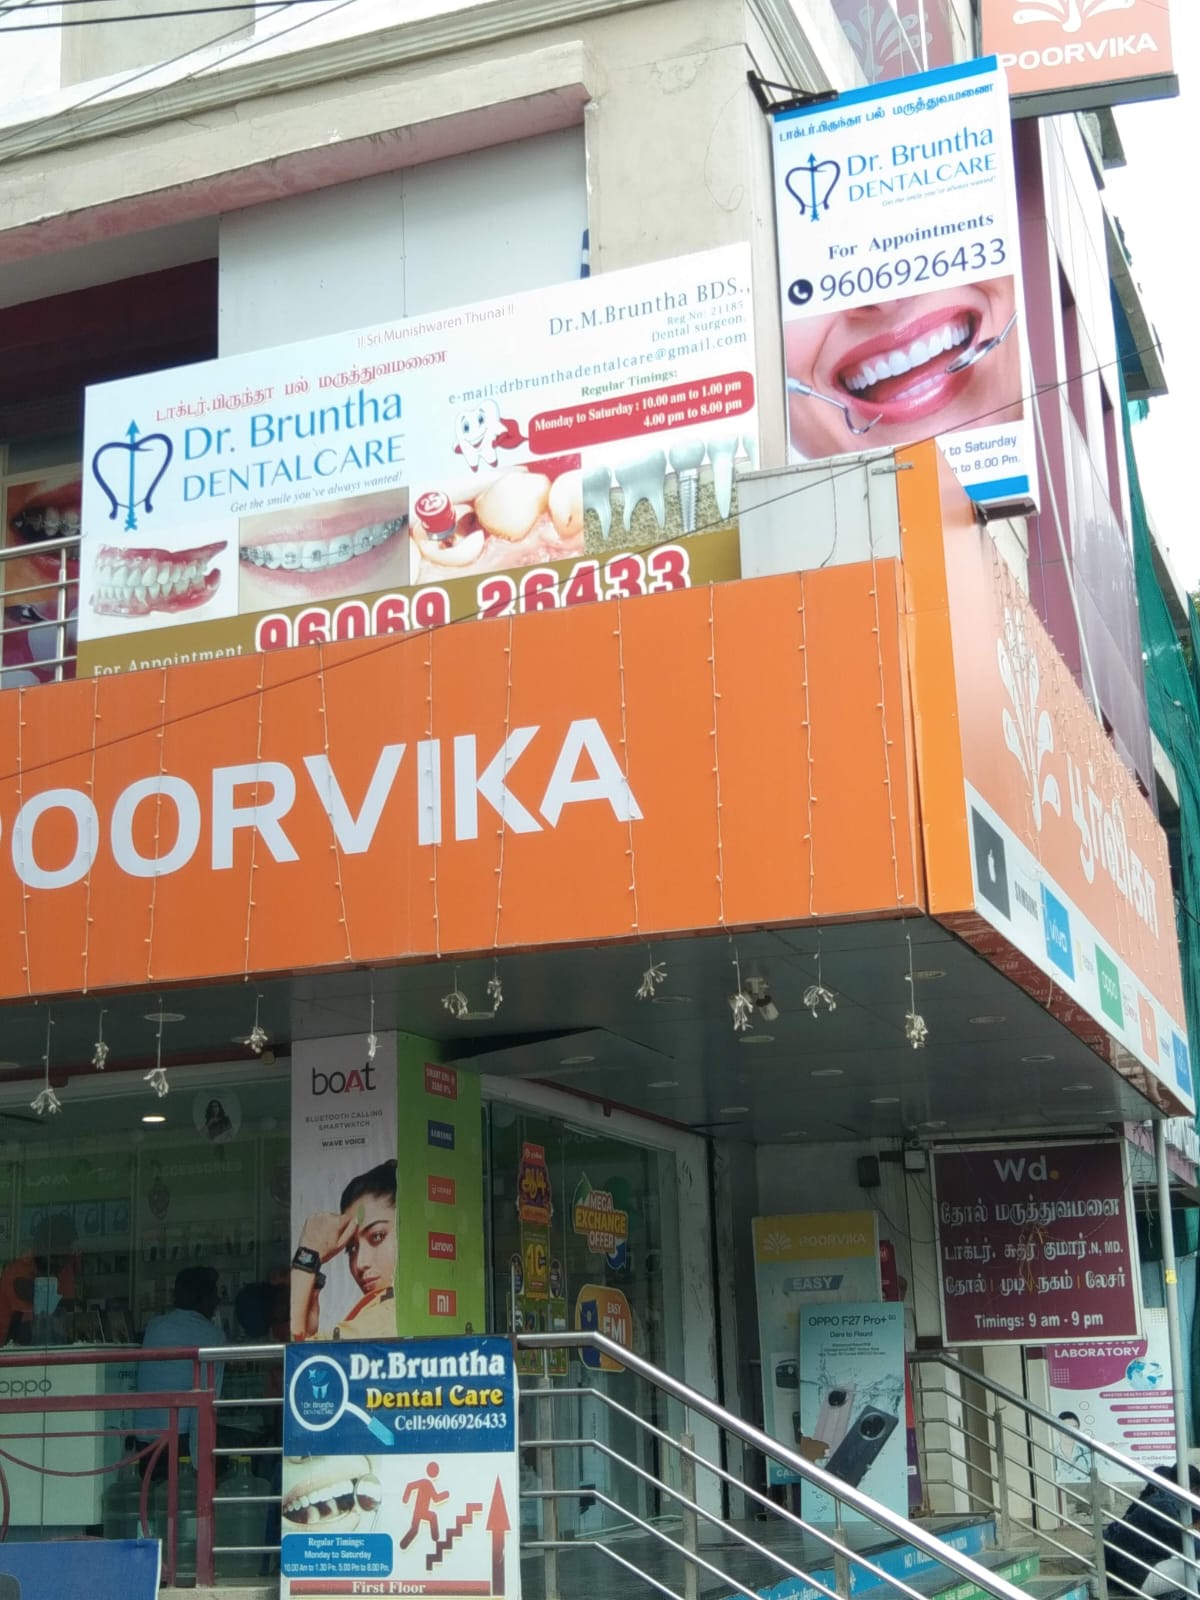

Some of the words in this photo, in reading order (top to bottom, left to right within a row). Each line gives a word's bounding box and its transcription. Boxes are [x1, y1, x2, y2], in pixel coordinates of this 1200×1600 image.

[1001, 32, 1158, 71] POORVIKA
[866, 106, 885, 121] பல்
[847, 153, 883, 177] Dr.
[892, 127, 993, 167] Bruntha
[828, 244, 858, 260] For
[868, 213, 994, 252] Appointments
[820, 238, 1006, 302] 9606926433
[549, 291, 688, 337] Dr.M.Bruntha
[697, 276, 751, 303] BDS.,
[367, 332, 381, 347] Sri
[384, 316, 462, 342] Munishwaren
[464, 305, 505, 325] Thunai
[667, 312, 686, 327] Reg
[651, 324, 690, 342] Dental
[285, 375, 309, 396] பல்
[581, 378, 624, 397] Regular
[627, 369, 677, 388] Timings:
[535, 415, 574, 433] Monday
[576, 411, 587, 424] to
[588, 404, 634, 421] Saturday
[642, 395, 668, 411] 10.00
[670, 392, 687, 404] am
[689, 389, 699, 400] to
[702, 383, 722, 398] 1.00
[724, 380, 742, 396] pm
[643, 412, 666, 428] 4.00
[668, 411, 685, 426] pm
[687, 407, 698, 419] to
[700, 401, 722, 416] 8.00
[725, 398, 743, 414] pm
[184, 425, 236, 461] Dr.
[250, 387, 402, 449] Bruntha
[949, 446, 961, 456] to
[965, 435, 1016, 454] Saturday
[961, 463, 971, 473] to
[974, 457, 999, 470] 8.00
[230, 499, 248, 513] Get
[250, 497, 264, 509] the
[267, 493, 291, 507] smile
[294, 487, 325, 505] you've
[327, 481, 361, 498] always
[364, 472, 403, 488] wanted!
[0, 717, 644, 890] OORVIKA
[305, 1112, 349, 1123] BLUETOOTH
[351, 1109, 383, 1120] CALLING
[318, 1120, 370, 1131] SMARTWATCH
[322, 1138, 343, 1148] WAVE
[345, 1137, 366, 1146] VOICE
[590, 1192, 612, 1211] MEGA
[941, 1198, 988, 1226] தோல்
[995, 1194, 1120, 1226] மருத்துவமனை
[575, 1209, 626, 1234] EXCHANGE
[431, 1239, 454, 1254] Lenovo
[589, 1232, 614, 1249] OFFER
[1104, 1241, 1123, 1253] MD.
[793, 1276, 833, 1290] EASY
[945, 1272, 986, 1297] தோல்
[1037, 1269, 1073, 1294] நகம்
[1085, 1266, 1126, 1289] லேசர்
[607, 1301, 622, 1315] EASY
[808, 1316, 840, 1327] OPPO
[841, 1315, 861, 1326] F27
[863, 1315, 887, 1326] Pro+
[975, 1314, 1024, 1331] Timings:
[1028, 1312, 1037, 1327] 9
[1041, 1314, 1060, 1327] am
[1071, 1311, 1080, 1326] 9
[1083, 1313, 1103, 1329] pm
[1054, 1346, 1140, 1358] LABORATORY
[350, 1349, 506, 1380] Dr.Bruntha
[366, 1386, 443, 1409] Dental
[449, 1384, 504, 1407] Care
[394, 1412, 507, 1431] Cell:9606926433
[308, 1537, 334, 1548] Regular
[335, 1536, 365, 1548] Timings:
[304, 1550, 330, 1561] Monday
[331, 1550, 340, 1558] to
[340, 1549, 371, 1560] Saturday
[352, 1581, 384, 1593] First
[389, 1581, 426, 1593] Floor
